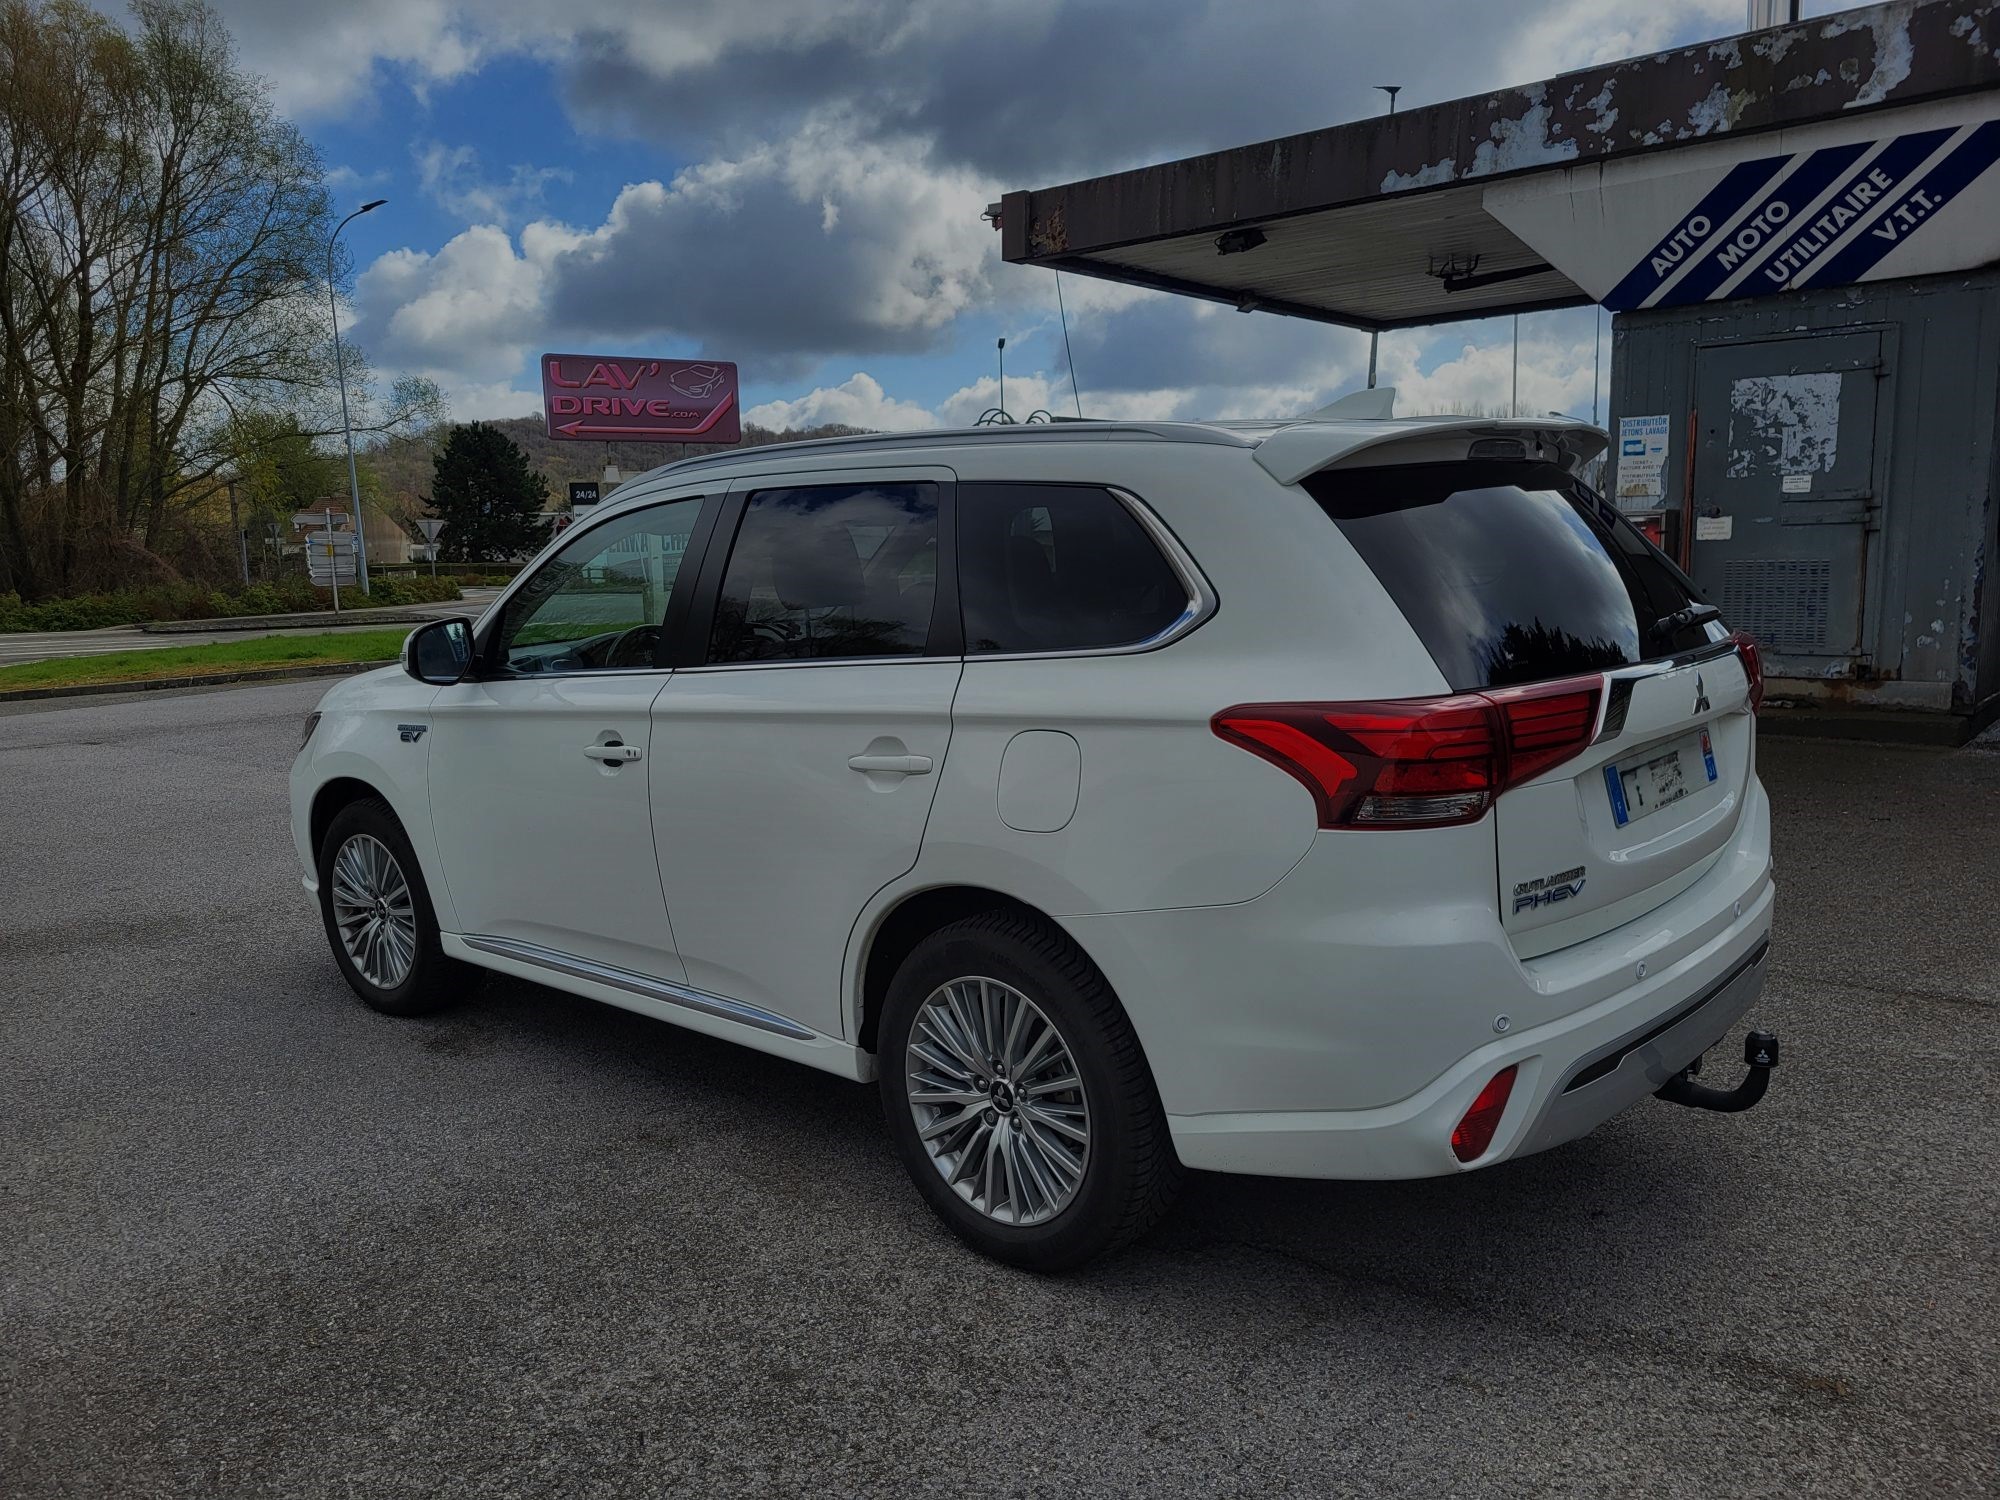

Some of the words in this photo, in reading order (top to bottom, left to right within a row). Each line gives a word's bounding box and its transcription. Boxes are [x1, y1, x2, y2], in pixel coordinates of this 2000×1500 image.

[1764, 167, 1893, 283] UTILITAIRE
[1872, 188, 1943, 242] V.T.T.
[1650, 215, 1711, 277] AUTO
[1715, 200, 1790, 271] MOTO
[549, 361, 661, 391] LAV'
[1621, 417, 1668, 427] DISTRIBUTEUR
[1645, 426, 1668, 435] LAVAGE
[575, 490, 597, 500] 24/24
[1512, 879, 1586, 916] PHEV
